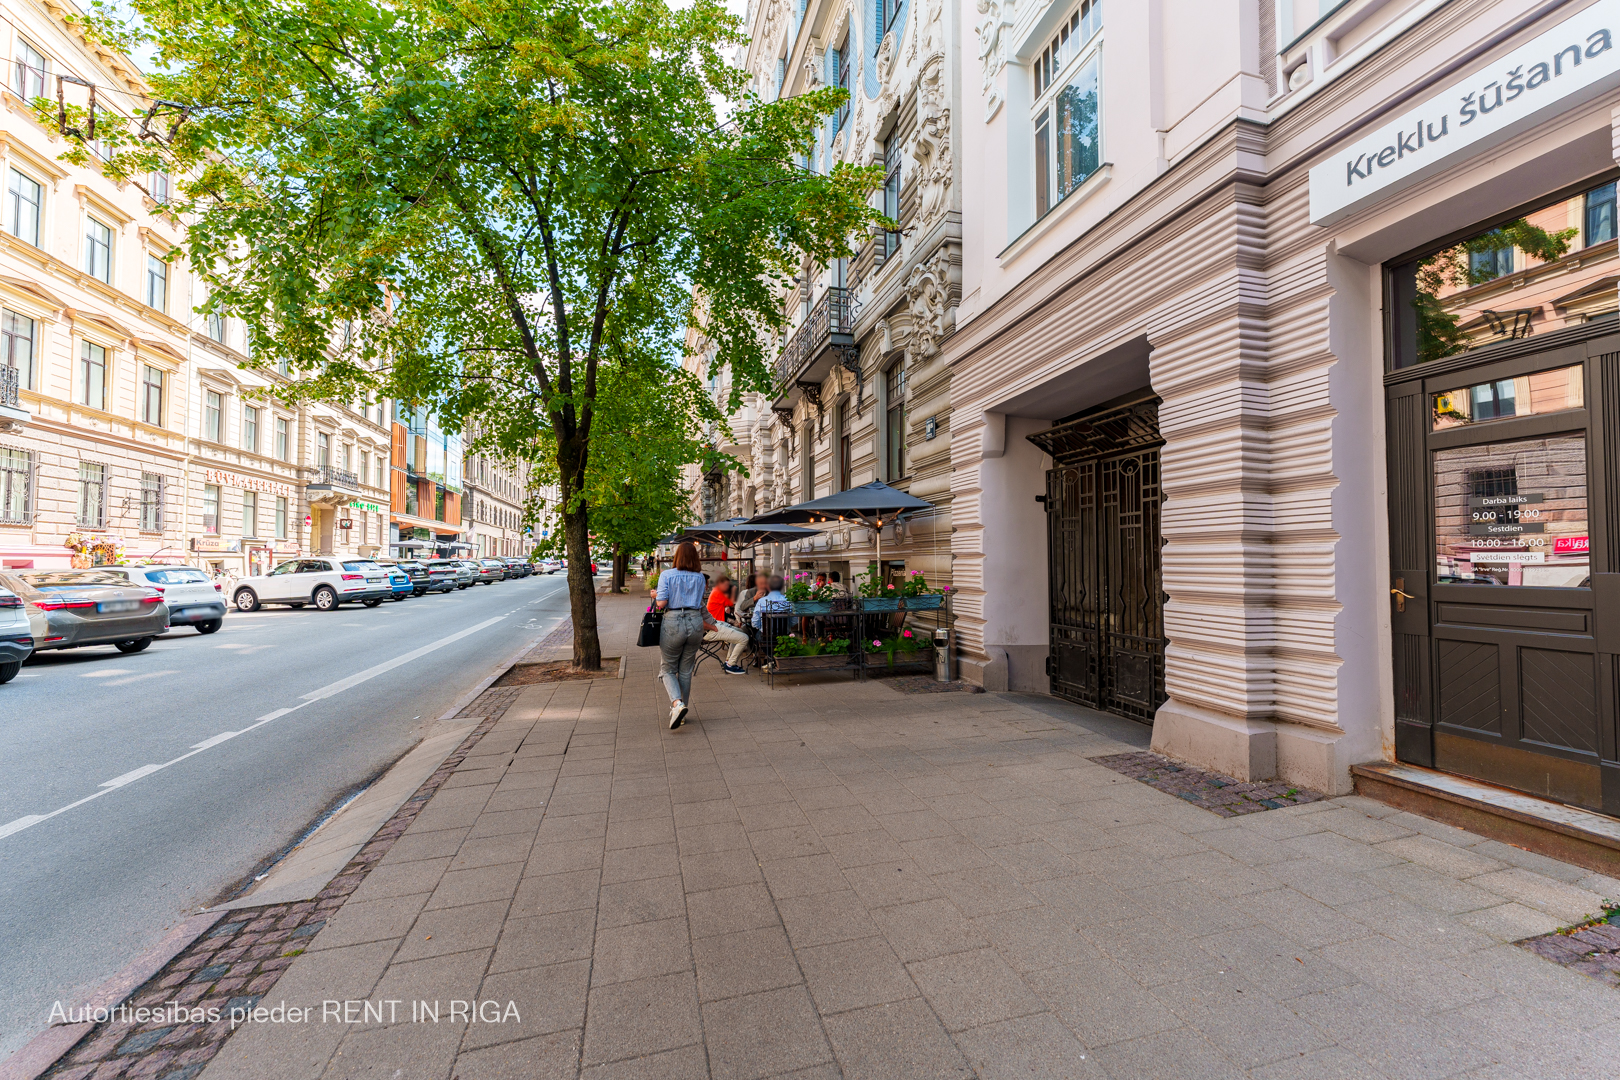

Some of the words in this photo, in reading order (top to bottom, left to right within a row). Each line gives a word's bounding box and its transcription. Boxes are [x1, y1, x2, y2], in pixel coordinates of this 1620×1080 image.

[1346, 114, 1449, 186] Kreklu
[1459, 27, 1613, 126] šūšana
[1482, 497, 1507, 505] Darba
[1472, 511, 1497, 520] 9.00
[1507, 509, 1540, 519] 19.00
[1488, 525, 1523, 533] Sestdien
[1471, 539, 1500, 547] 10.00
[1511, 538, 1545, 547] 16.00
[1513, 553, 1538, 562] slēgts
